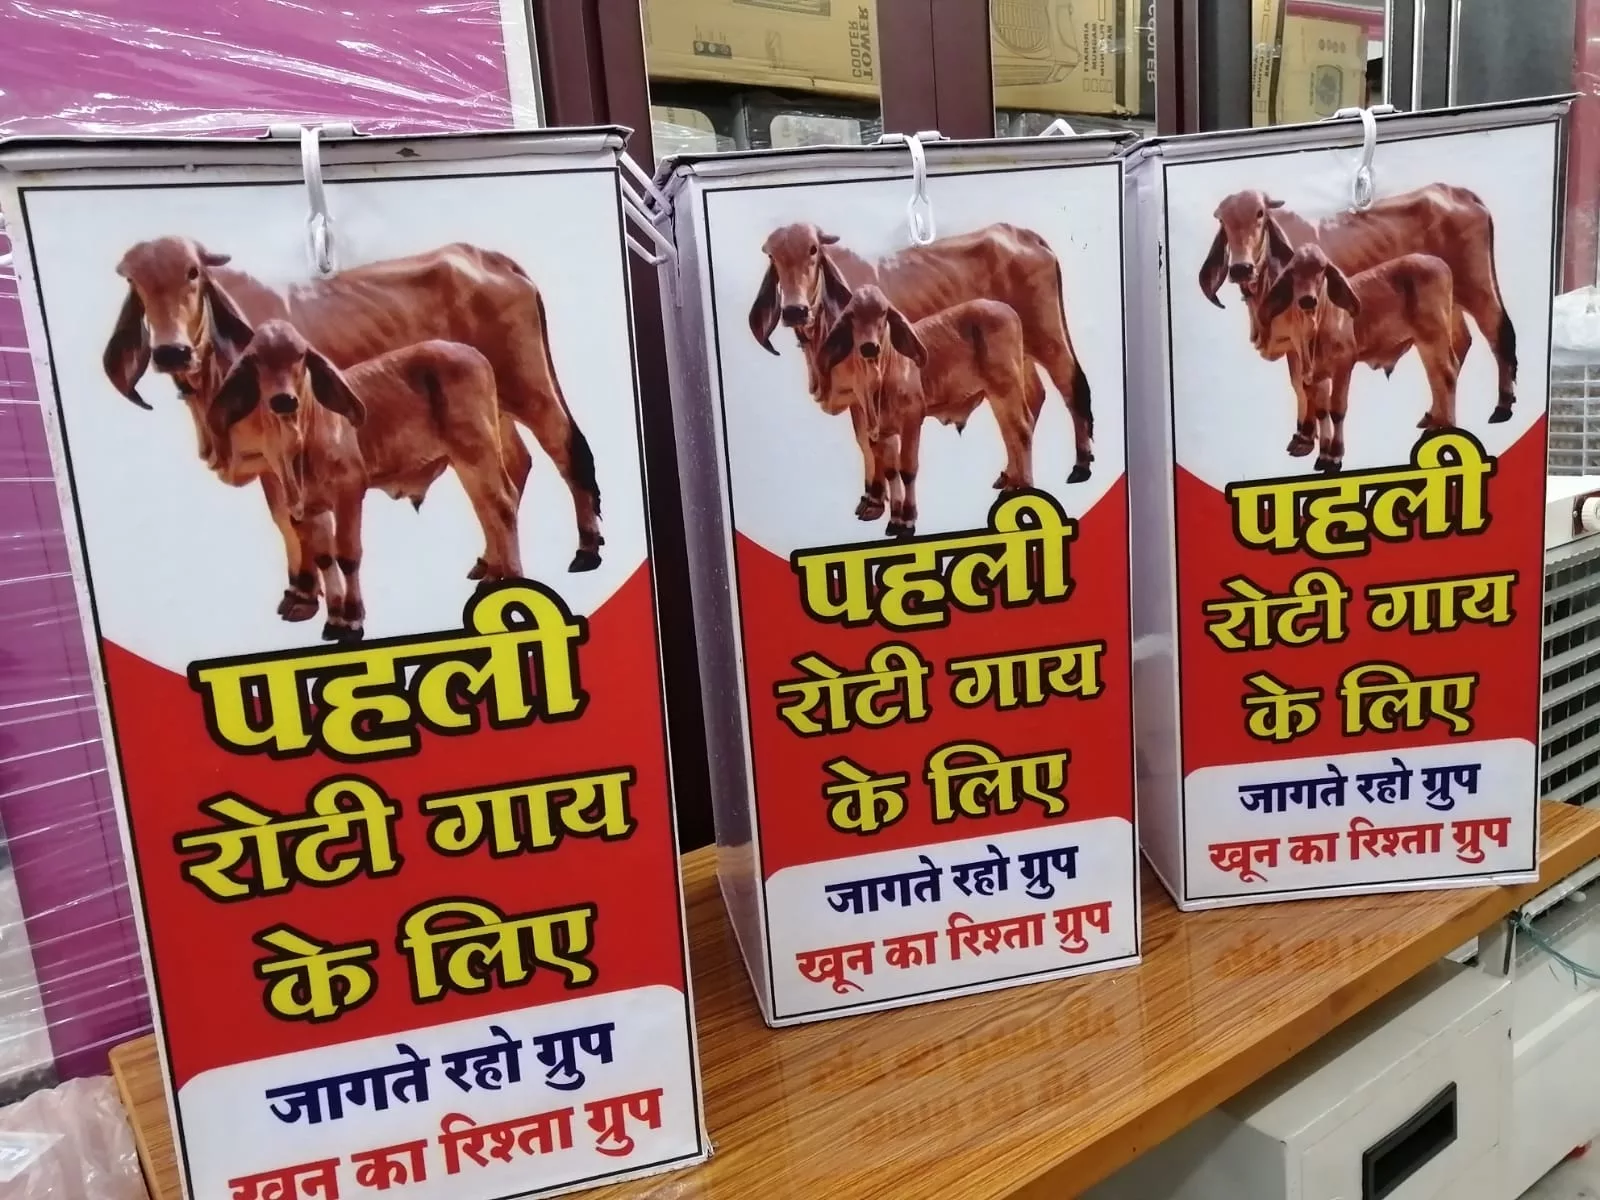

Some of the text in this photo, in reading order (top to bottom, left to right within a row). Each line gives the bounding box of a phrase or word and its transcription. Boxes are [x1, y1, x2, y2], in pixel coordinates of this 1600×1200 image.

[1227, 429, 1496, 558] पहली
[792, 489, 1076, 631] पहली
[1204, 569, 1517, 650] रोटी गाय
[191, 580, 587, 760] पहली
[776, 642, 1104, 734] रोटी गाय
[1244, 662, 1478, 742] के लिए
[824, 742, 1069, 833] के लिए
[1239, 757, 1481, 813] जागते रहो ग्रुप
[177, 768, 633, 898] रोटी गाय
[824, 844, 1079, 914] जागते रहो ग्रुप
[1208, 816, 1512, 883] खून का रिश्ता ग्रुप
[254, 899, 594, 1021] के लिए
[796, 901, 1112, 994] खून का रिश्ता ग्रुप
[265, 1021, 615, 1125] जागते रहो ग्रुप
[351, 1138, 428, 1191] का
[437, 1112, 574, 1175] रिश्ता
[583, 1087, 664, 1157] ग्रुप
